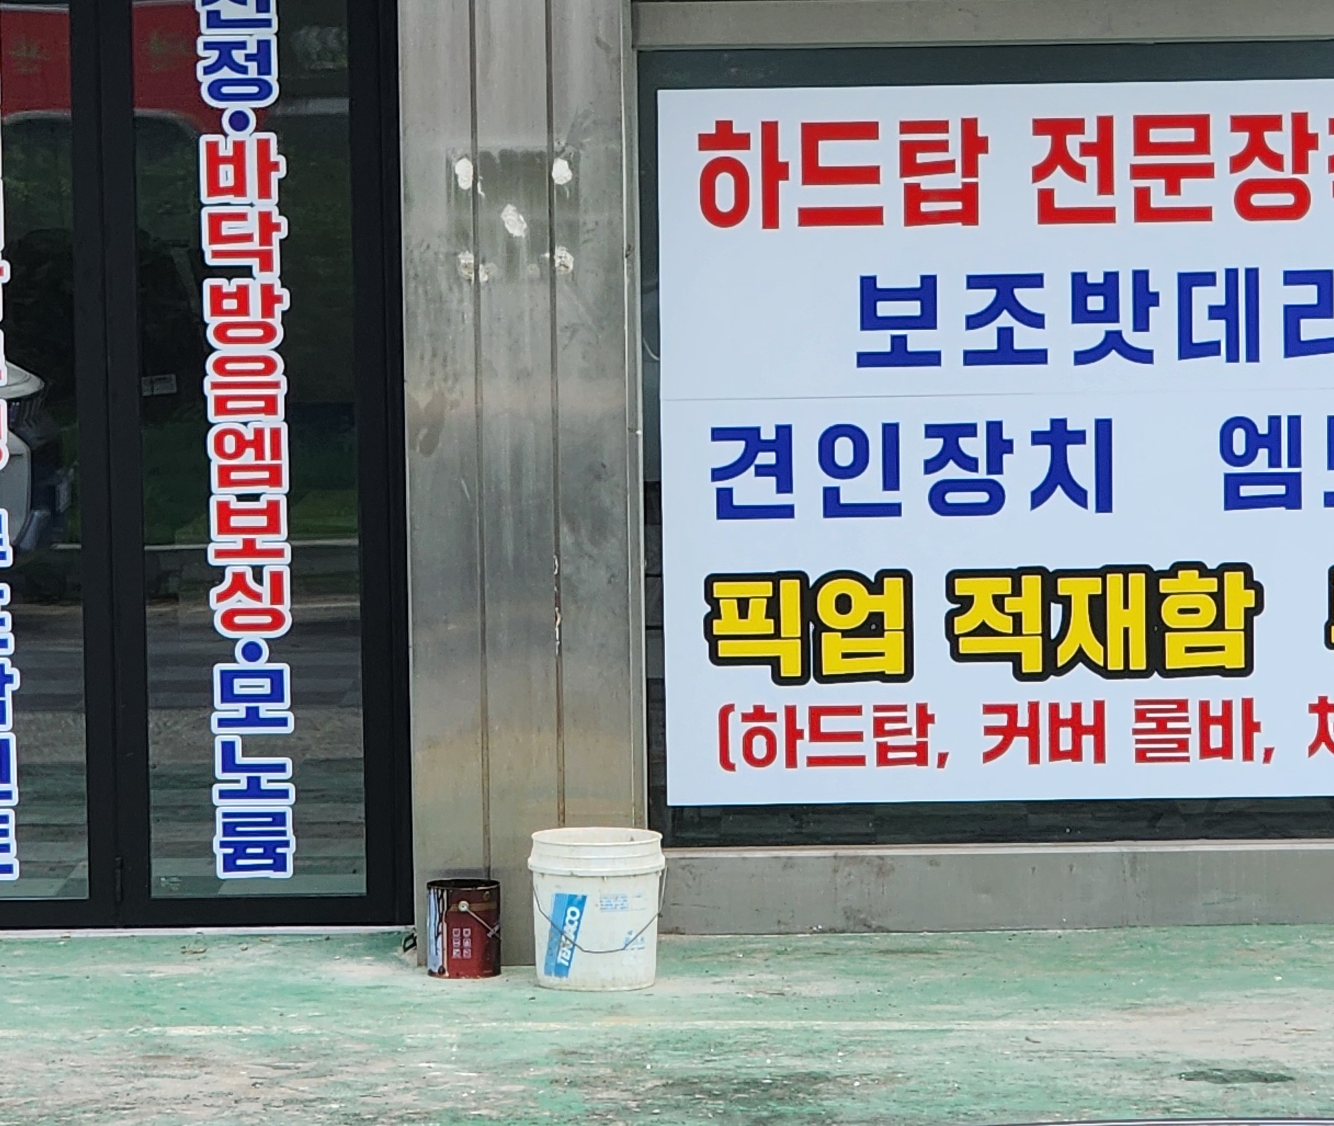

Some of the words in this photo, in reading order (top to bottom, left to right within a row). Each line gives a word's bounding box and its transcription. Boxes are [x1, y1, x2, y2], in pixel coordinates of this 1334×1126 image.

[696, 116, 990, 231] 하드탑
[708, 417, 1115, 522] 견인장치
[704, 568, 915, 686] 픽업
[946, 561, 1265, 681] 적재함
[717, 702, 951, 772] (하드탑,
[981, 699, 1107, 767] 커버
[1131, 696, 1276, 766] 롤바,
